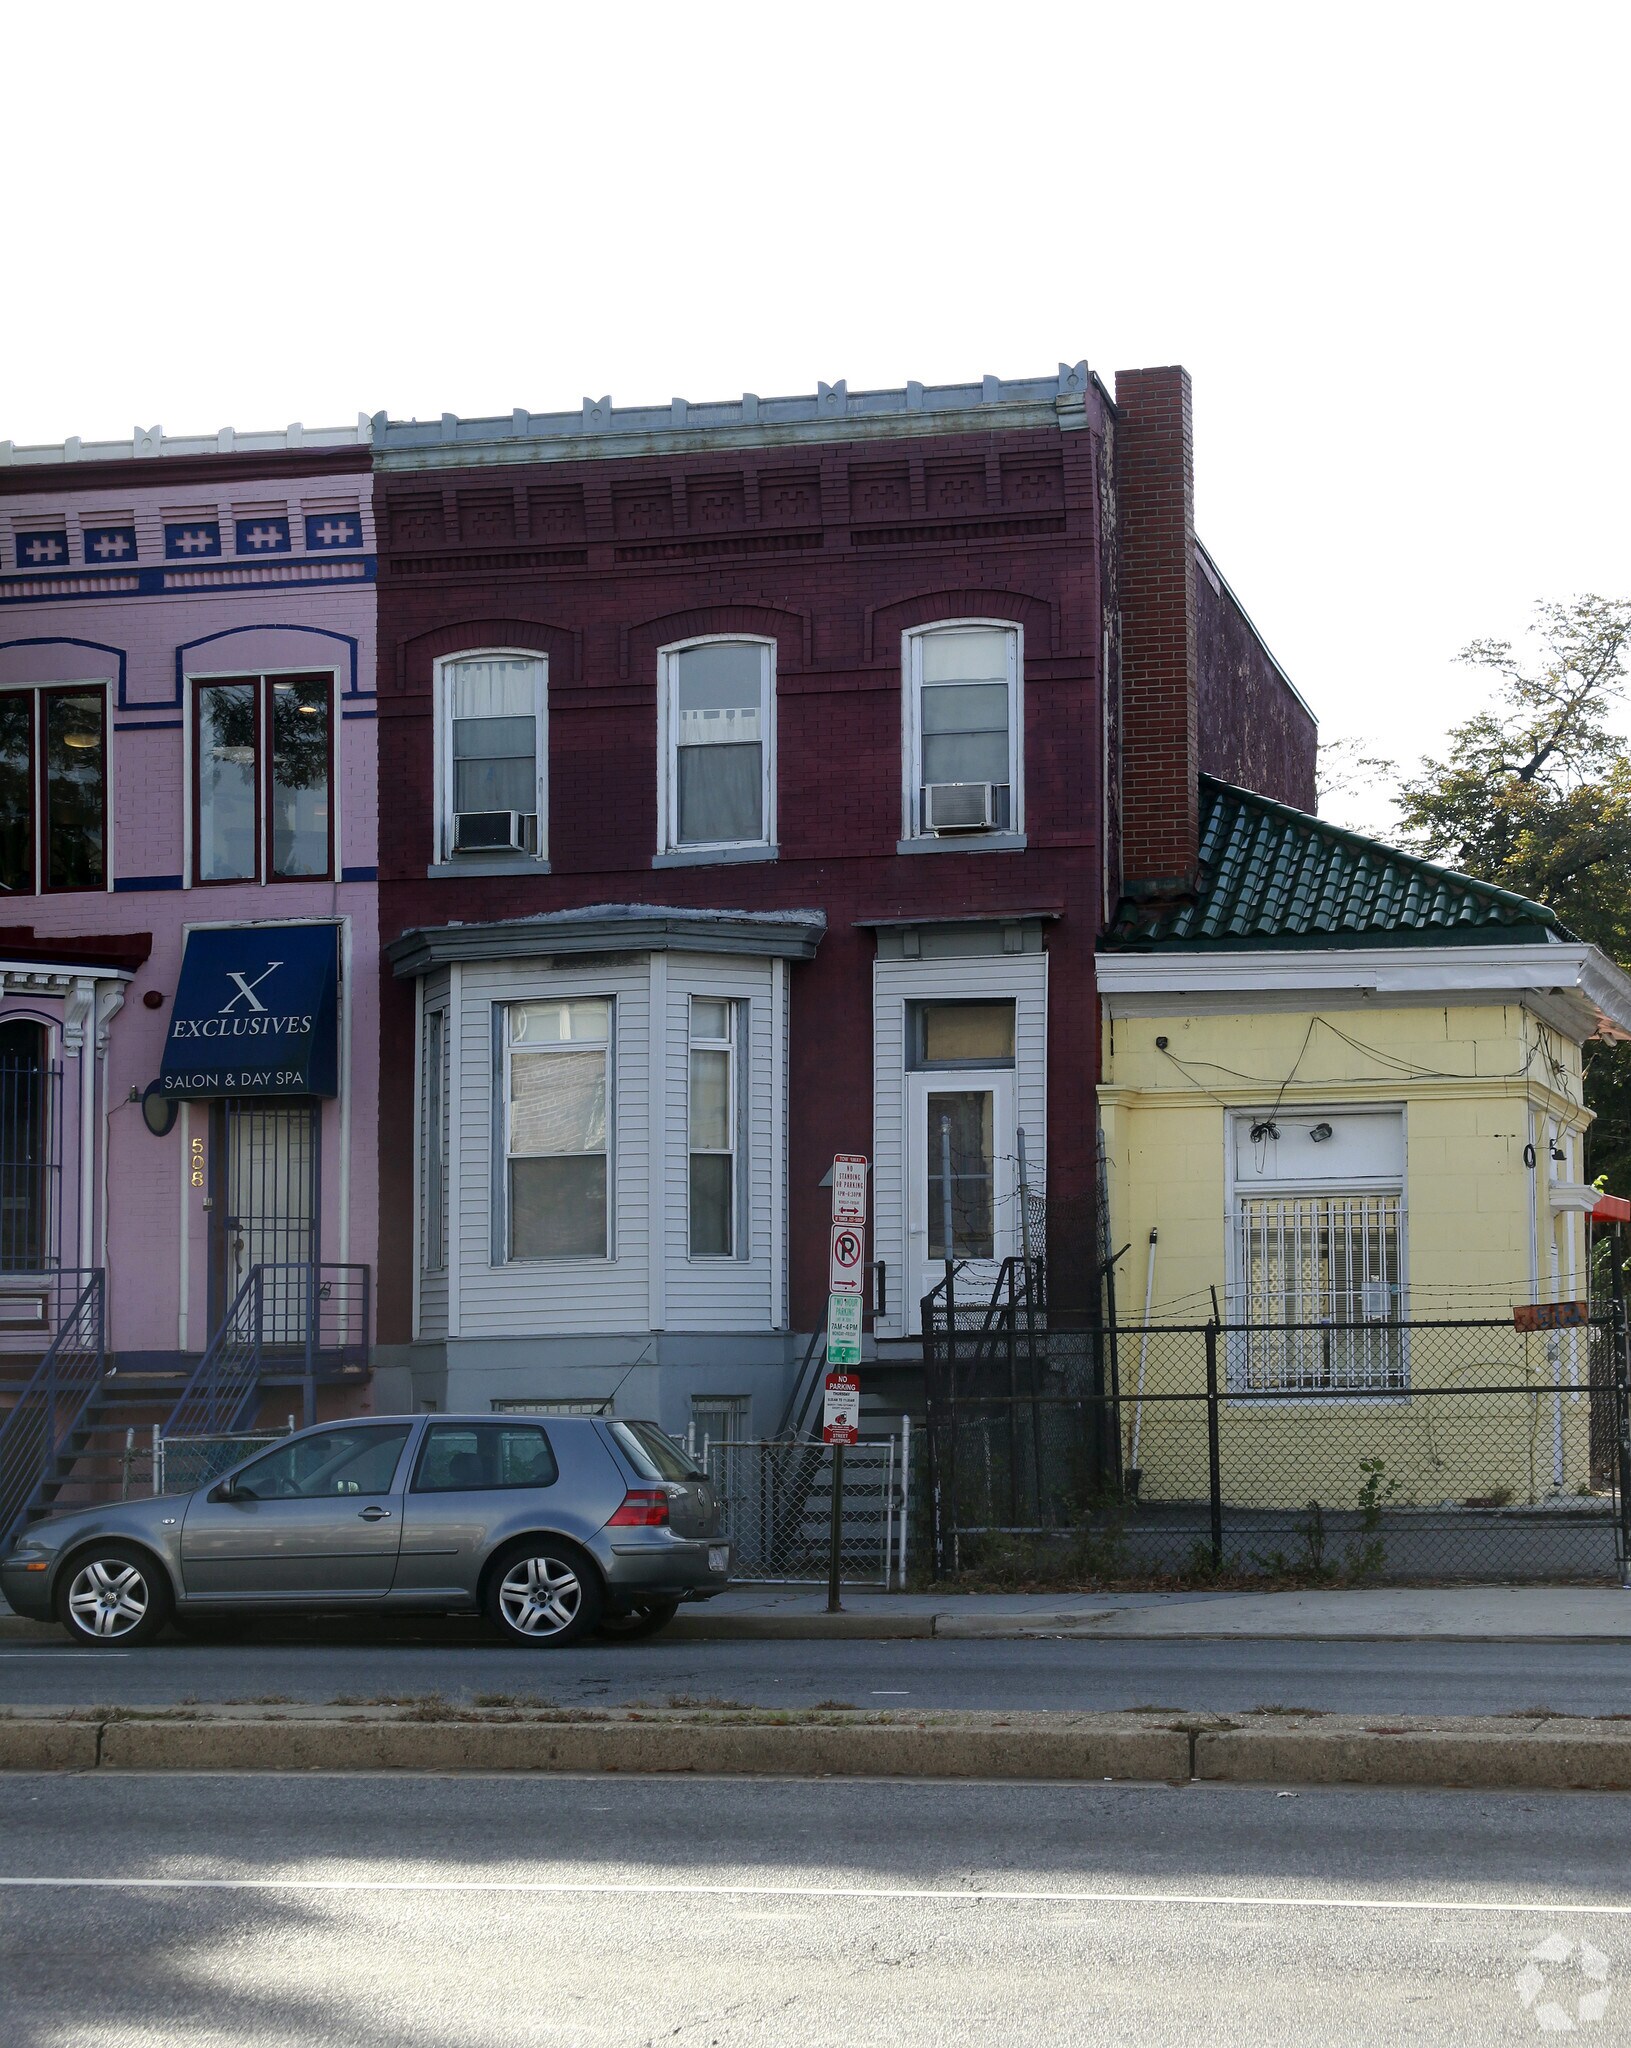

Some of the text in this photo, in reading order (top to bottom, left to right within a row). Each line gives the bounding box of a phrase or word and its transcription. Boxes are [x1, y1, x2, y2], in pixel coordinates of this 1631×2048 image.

[218, 961, 284, 1013] X
[172, 1015, 312, 1038] EXCLUSIVES
[164, 1071, 304, 1089] SALON & DAY SPA
[191, 1138, 205, 1187] 508
[839, 1172, 861, 1181] STANDING
[843, 1181, 864, 1189] PARKING
[836, 1306, 855, 1316] PARKING
[841, 1347, 846, 1357] 2
[838, 1375, 848, 1383] NO
[829, 1382, 856, 1391] PARKING
